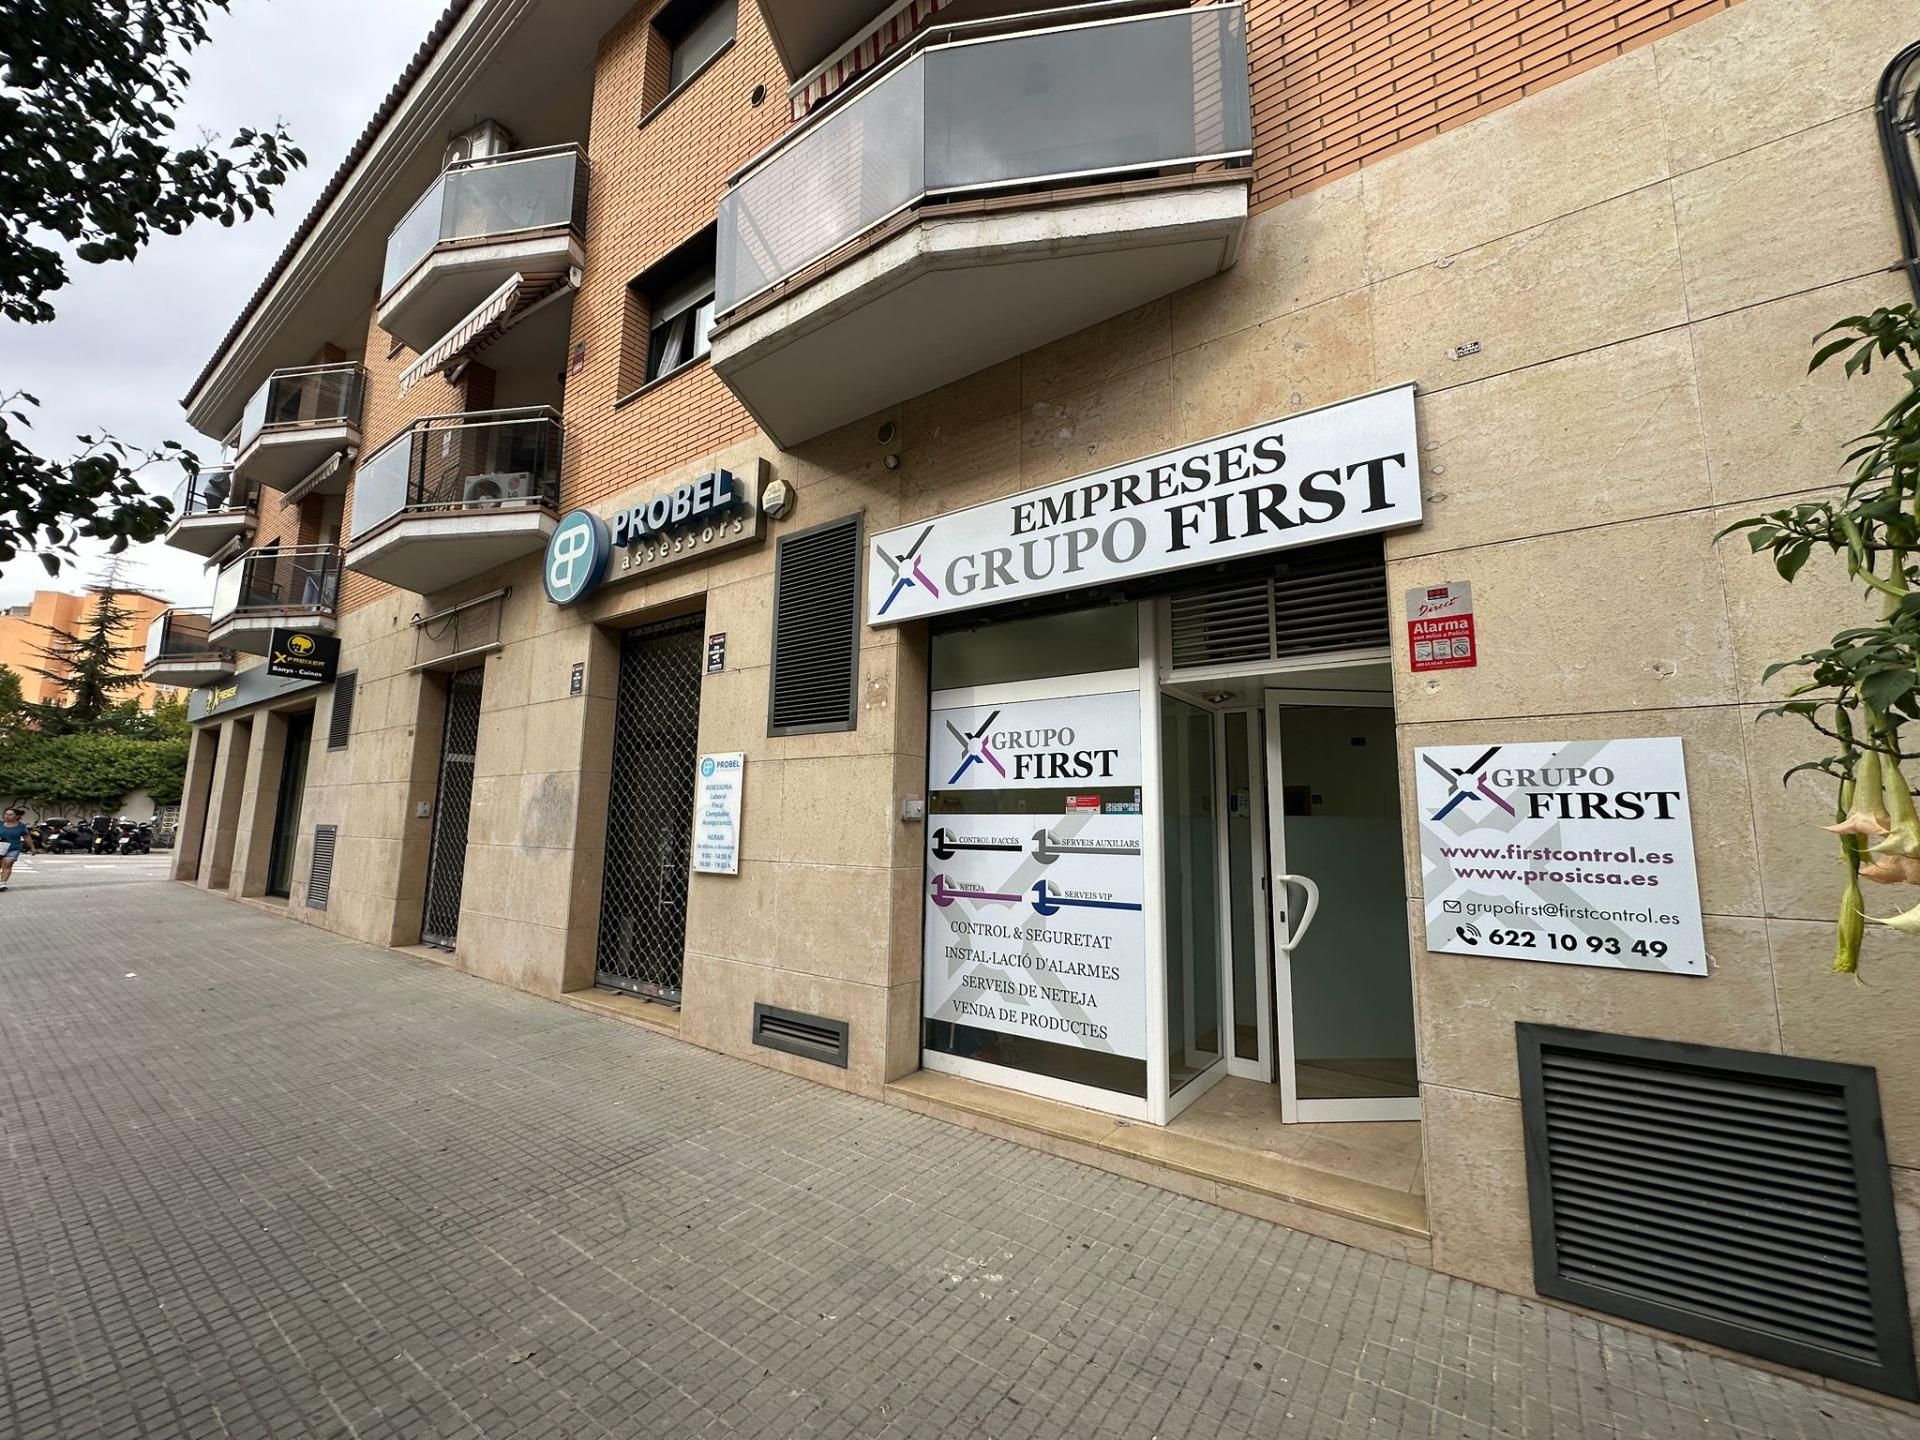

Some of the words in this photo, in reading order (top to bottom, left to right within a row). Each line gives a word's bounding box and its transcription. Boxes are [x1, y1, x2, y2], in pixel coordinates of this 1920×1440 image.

[507, 490, 518, 498] LG
[1010, 433, 1287, 537] EMPRESES
[611, 468, 732, 546] PROBEL
[944, 516, 1147, 597] GRUPO
[1164, 452, 1406, 553] FIRST
[621, 516, 743, 571] assessors
[1413, 619, 1469, 635] Alarma
[272, 665, 294, 674] Banys
[991, 727, 1075, 750] GRUPO
[716, 760, 741, 768] PROBEL
[1013, 749, 1118, 780] FIRST
[1491, 766, 1615, 788] GRUPO
[1525, 791, 1680, 820] FIRST
[1061, 838, 1094, 847] SERVEIS
[1095, 839, 1140, 848] AUXILIARS
[1440, 844, 1675, 864] www.firstcontrol.es
[960, 883, 985, 892] NETEJA
[1454, 867, 1659, 887] www.prosicsa.es
[1064, 890, 1098, 899] SERVEIS
[1099, 892, 1113, 901] VIP
[1466, 901, 1680, 925] grupofirst@firstcontrol.es
[950, 920, 1010, 939] CONTROL
[1013, 927, 1023, 940] &
[1026, 928, 1112, 950] SEGURETAT
[1489, 929, 1537, 948] 622
[1548, 933, 1578, 951] 10
[1586, 936, 1622, 955] 93
[1631, 939, 1668, 958] 49
[1036, 957, 1120, 981] D'ALARMES
[962, 974, 1015, 995] SERVEIS
[1019, 984, 1038, 998] DE
[1040, 986, 1098, 1008] NETEJA
[952, 1000, 995, 1019] VENDA
[999, 1007, 1017, 1023] DE
[1021, 1011, 1108, 1039] PRODUCTES
